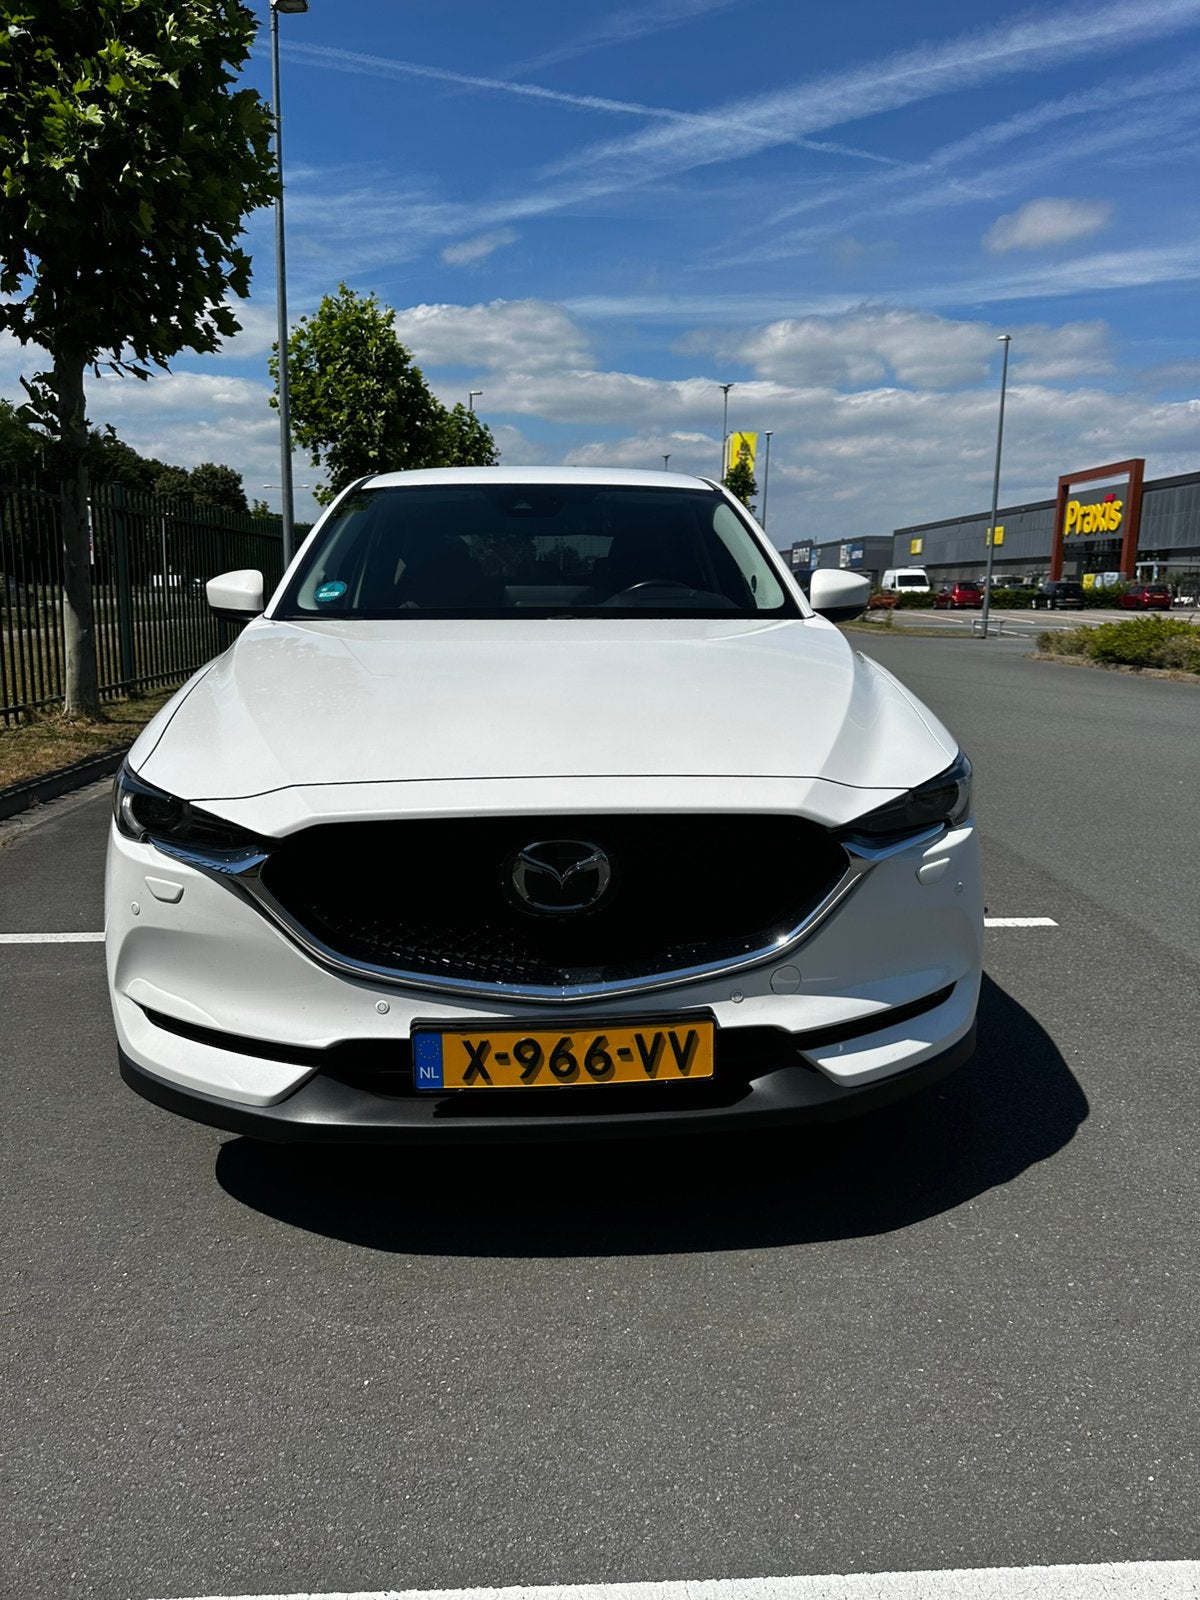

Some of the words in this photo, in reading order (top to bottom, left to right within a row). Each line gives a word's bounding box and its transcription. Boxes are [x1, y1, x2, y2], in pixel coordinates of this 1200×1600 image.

[1064, 494, 1122, 536] Praxis
[419, 1066, 440, 1079] NL
[462, 1029, 698, 1083] X-966-VV
